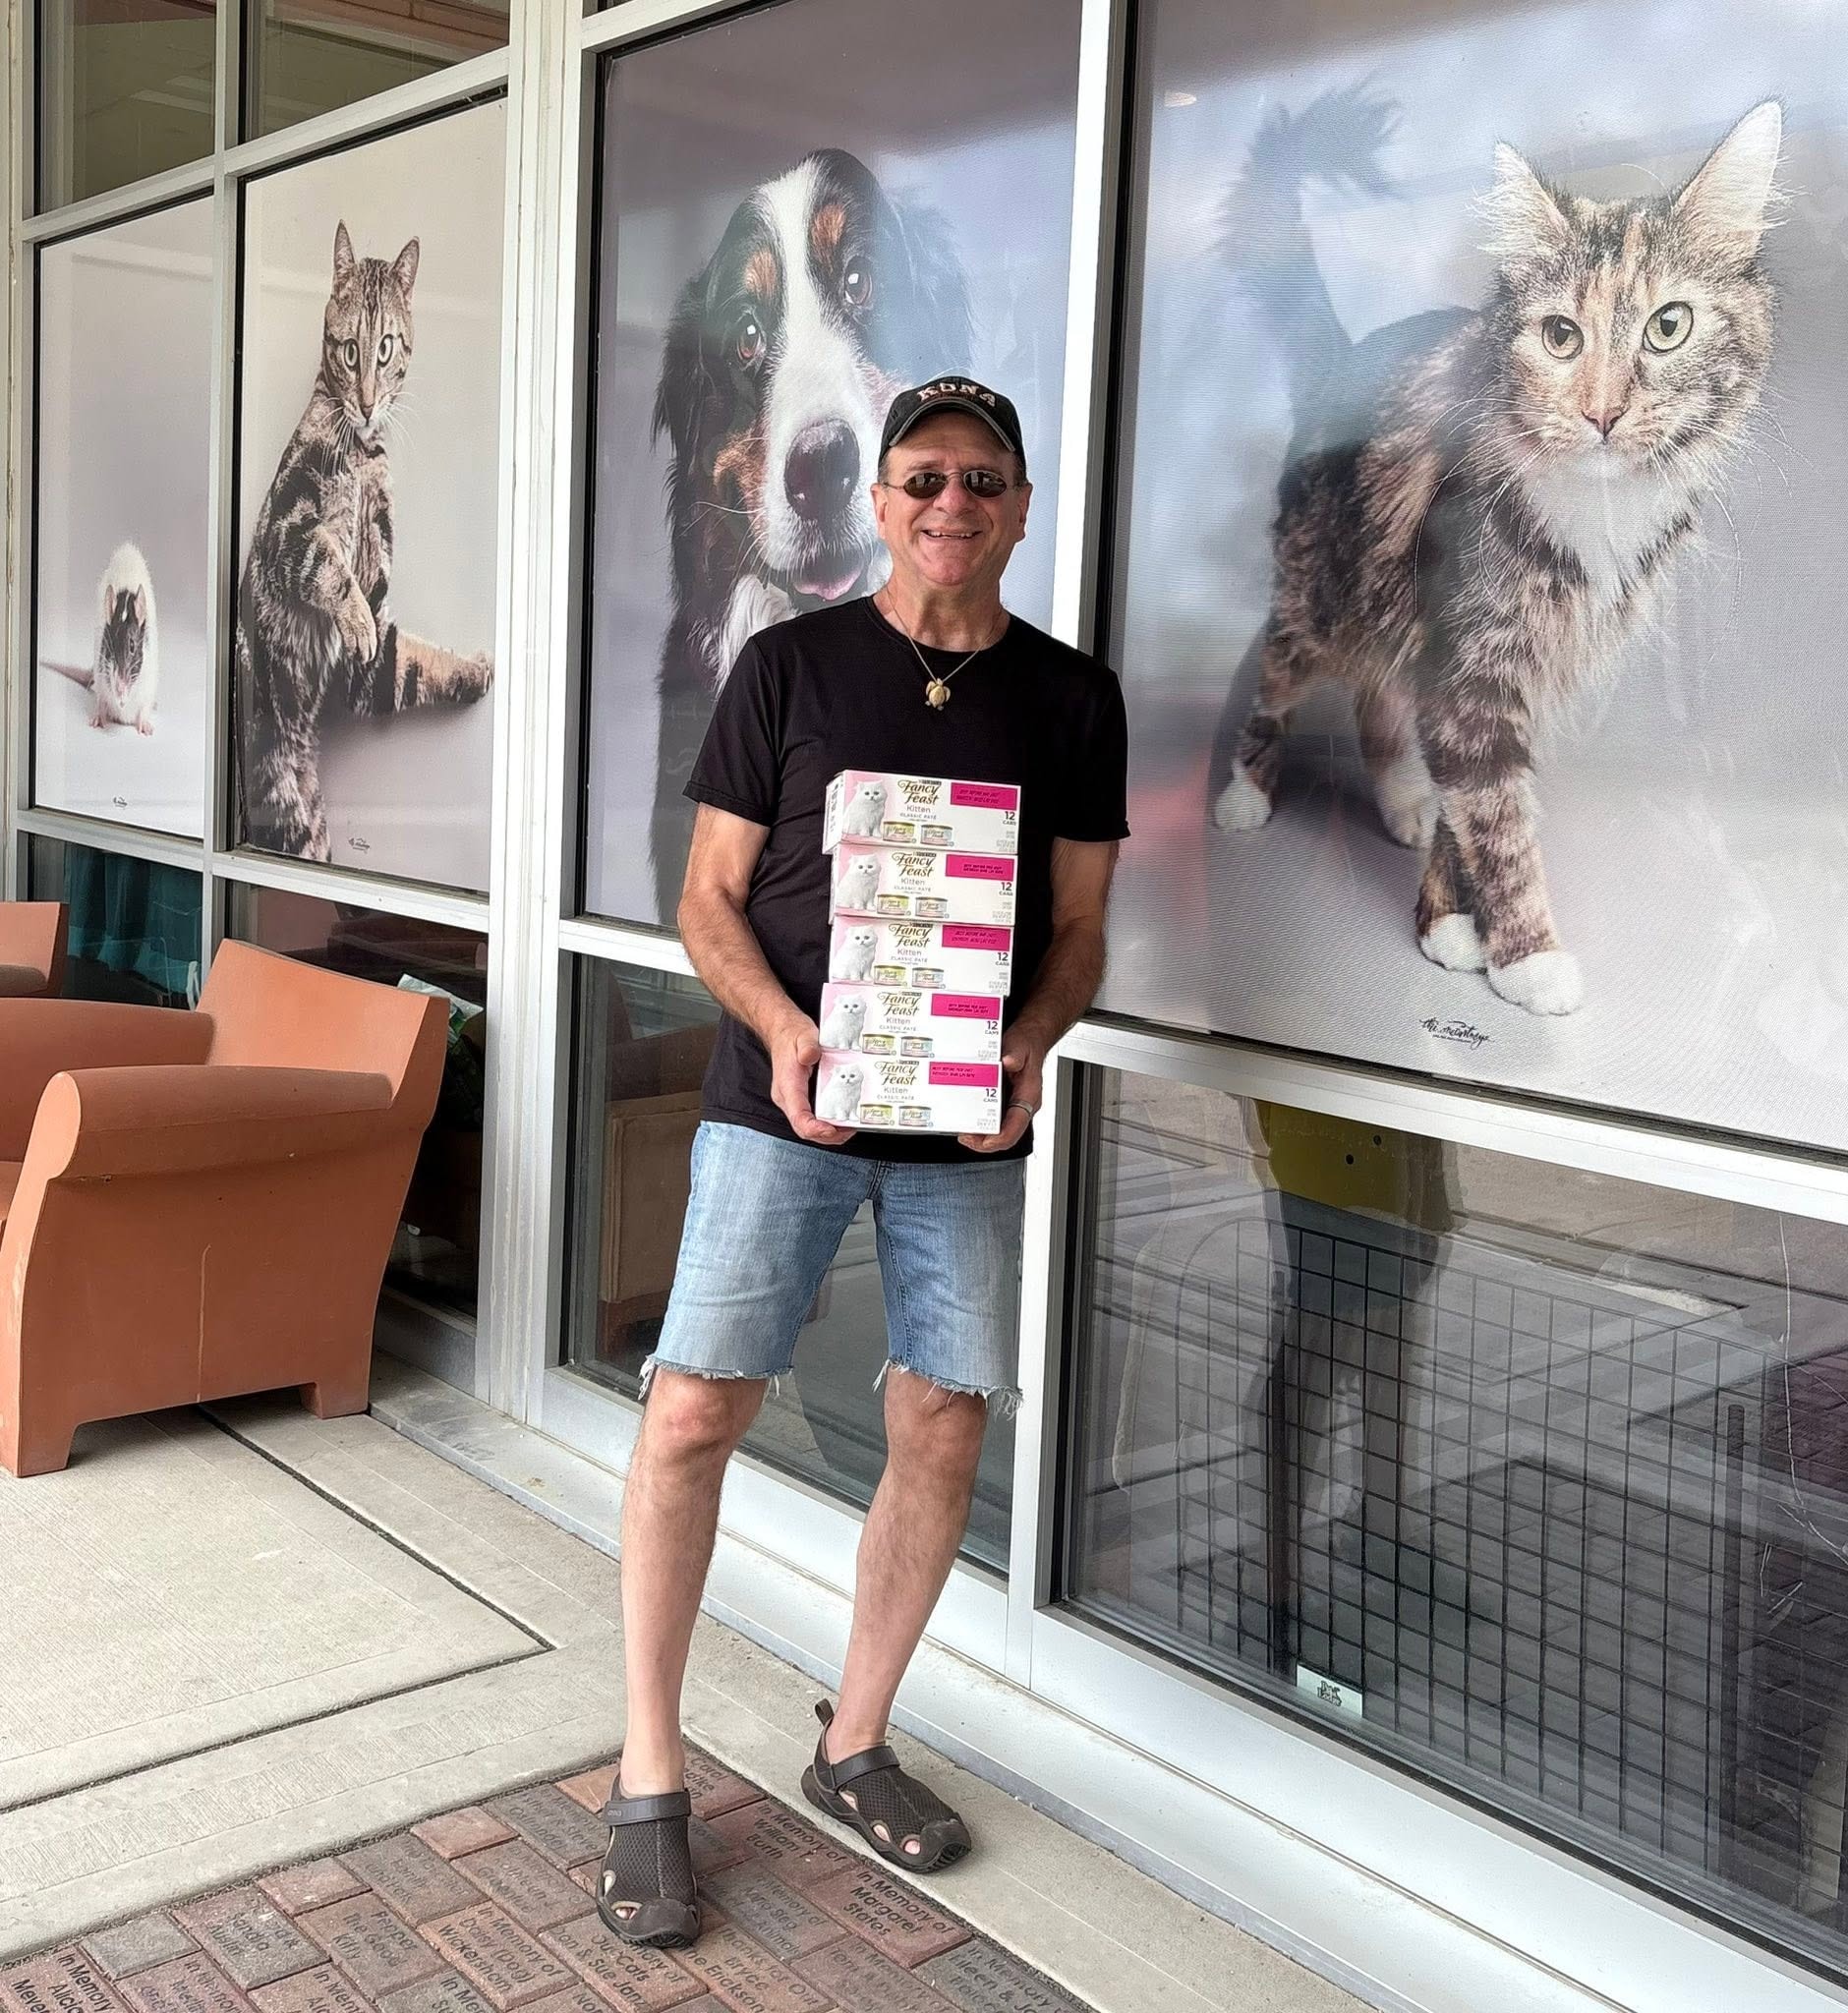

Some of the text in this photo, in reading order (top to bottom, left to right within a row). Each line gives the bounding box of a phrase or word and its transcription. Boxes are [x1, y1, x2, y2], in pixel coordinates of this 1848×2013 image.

[897, 779, 941, 794] Fancy
[904, 791, 939, 805] Feast
[1005, 811, 1015, 820] 12
[892, 852, 935, 868] Fancy
[898, 865, 934, 877] Feast
[1001, 882, 1012, 891] 12
[889, 924, 932, 940] Fancy
[895, 936, 930, 948] Feast
[997, 952, 1009, 961] 12
[877, 992, 921, 1006] Fancy
[884, 1004, 919, 1016] Feast
[986, 1020, 998, 1030] 12
[874, 1062, 918, 1076] Fancy
[881, 1072, 917, 1085] Feast
[985, 1088, 997, 1098] 12
[753, 1818, 799, 1853] William
[758, 1805, 847, 1862] In Memory of
[746, 1833, 783, 1860] Barth
[766, 1878, 811, 1918] Memory
[808, 1916, 828, 1927] of
[850, 1886, 923, 1933] Margaret
[857, 1870, 956, 1933] In Memory of
[842, 1902, 892, 1935] States
[459, 1917, 494, 1948] Daisy
[490, 1918, 544, 1963] Memory
[541, 1964, 566, 1977] of
[719, 1927, 767, 1965] Thanks
[437, 1924, 512, 1992] Wickersham
[576, 1947, 593, 1961] &
[589, 1958, 616, 1980] Sue
[314, 1970, 329, 1984] In
[664, 1971, 687, 1984] of
[724, 1957, 770, 1990] Bryce
[968, 1946, 1052, 2007] In Memory
[58, 1953, 116, 2012] In Memory
[440, 1977, 458, 1991] In
[11, 1979, 50, 2013] Meye
[999, 1989, 1014, 2002] &
